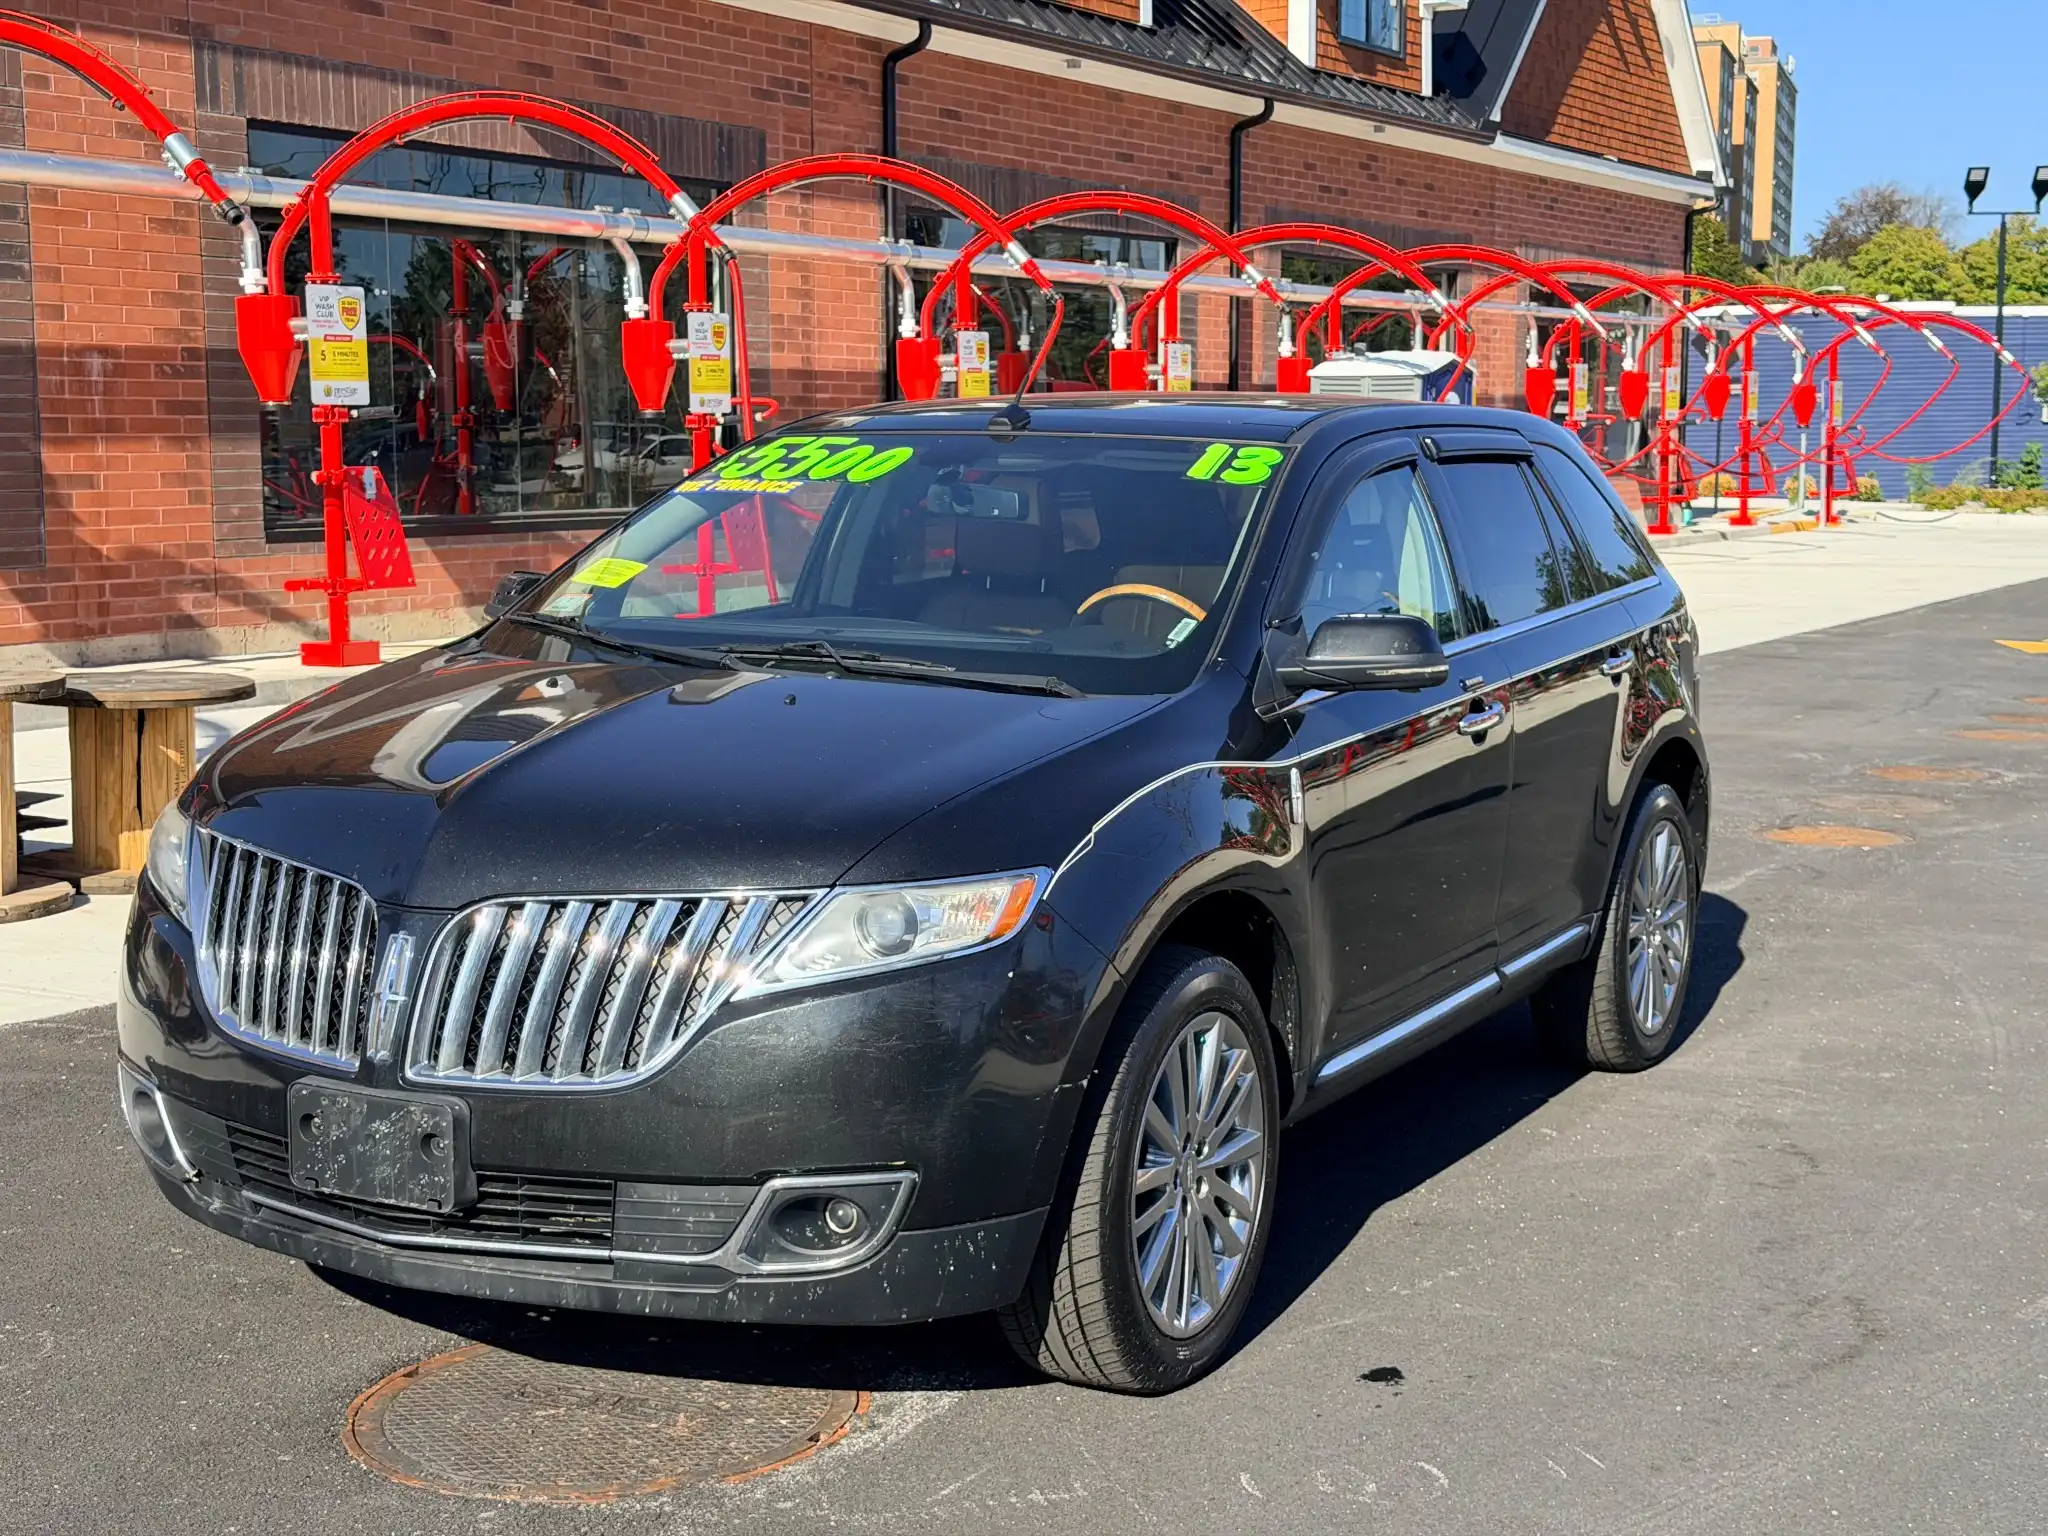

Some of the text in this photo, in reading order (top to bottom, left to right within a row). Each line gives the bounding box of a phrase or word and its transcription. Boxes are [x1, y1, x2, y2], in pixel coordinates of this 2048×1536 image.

[320, 350, 327, 361] 5
[712, 436, 914, 483] $5500
[1186, 443, 1284, 485] 13
[706, 480, 804, 493] FINANCE
